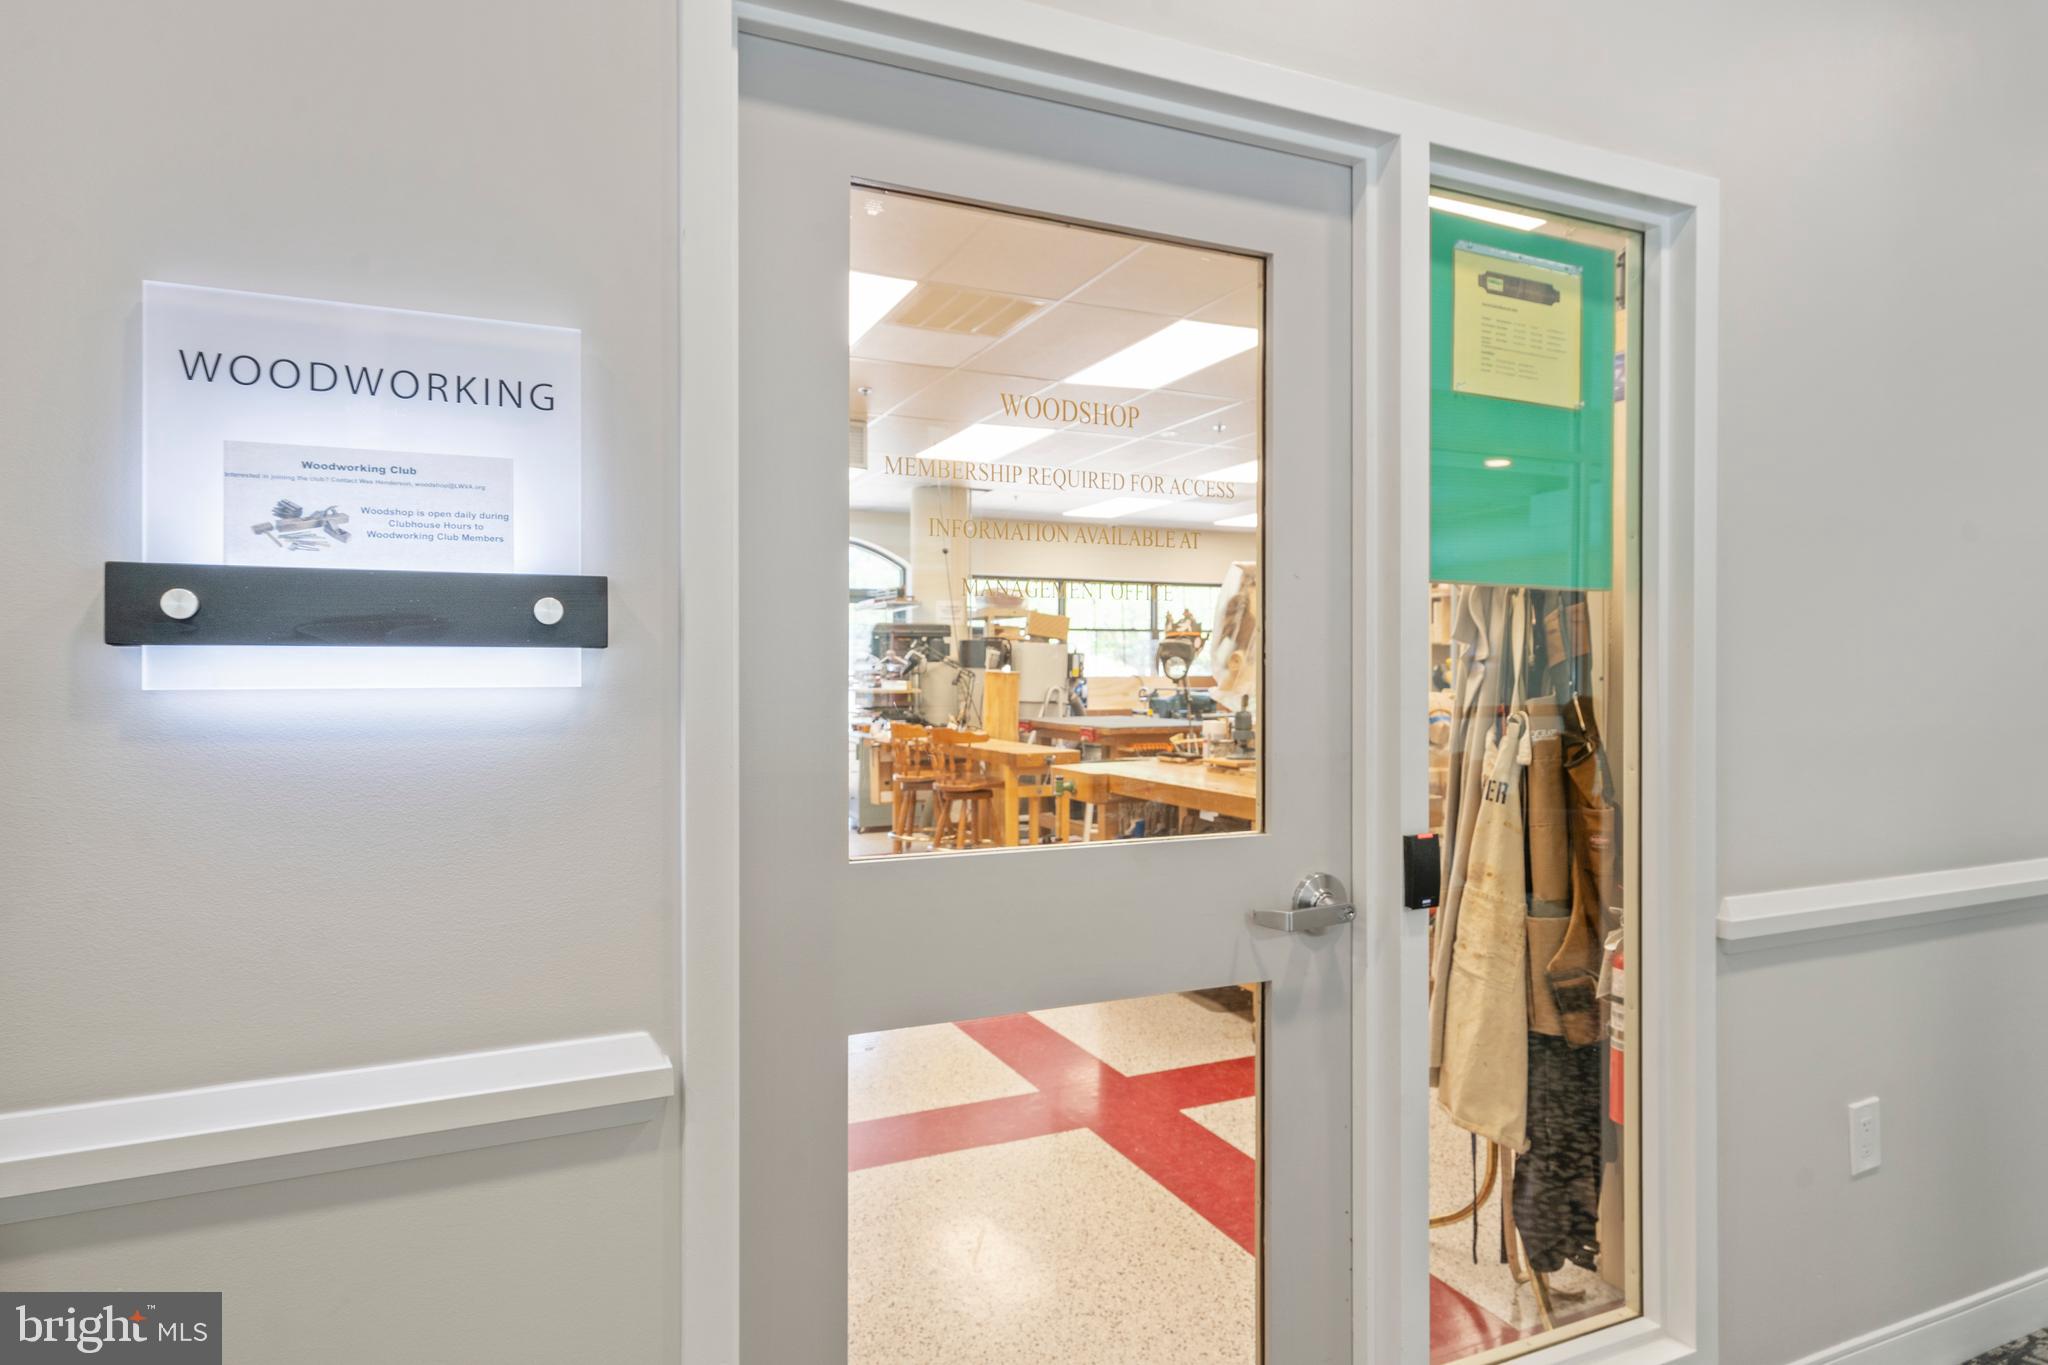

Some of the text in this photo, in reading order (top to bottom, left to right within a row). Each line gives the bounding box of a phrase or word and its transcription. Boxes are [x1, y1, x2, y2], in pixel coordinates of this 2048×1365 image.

[178, 348, 556, 412] WOODWORKING
[1000, 392, 1140, 429] WOODSHOP
[301, 460, 417, 476] Woodworking Club
[884, 454, 1235, 500] MEMBERSHIP REQUIRED FOR ACCESS
[360, 506, 510, 522] Woodshop is open daily during
[388, 519, 484, 531] Clubhouse Hours to
[367, 530, 504, 543] Woodworking Club Members
[928, 517, 1202, 551] INFORMATION AVAILABLE AT
[962, 577, 1104, 600] MANAGEMENT
